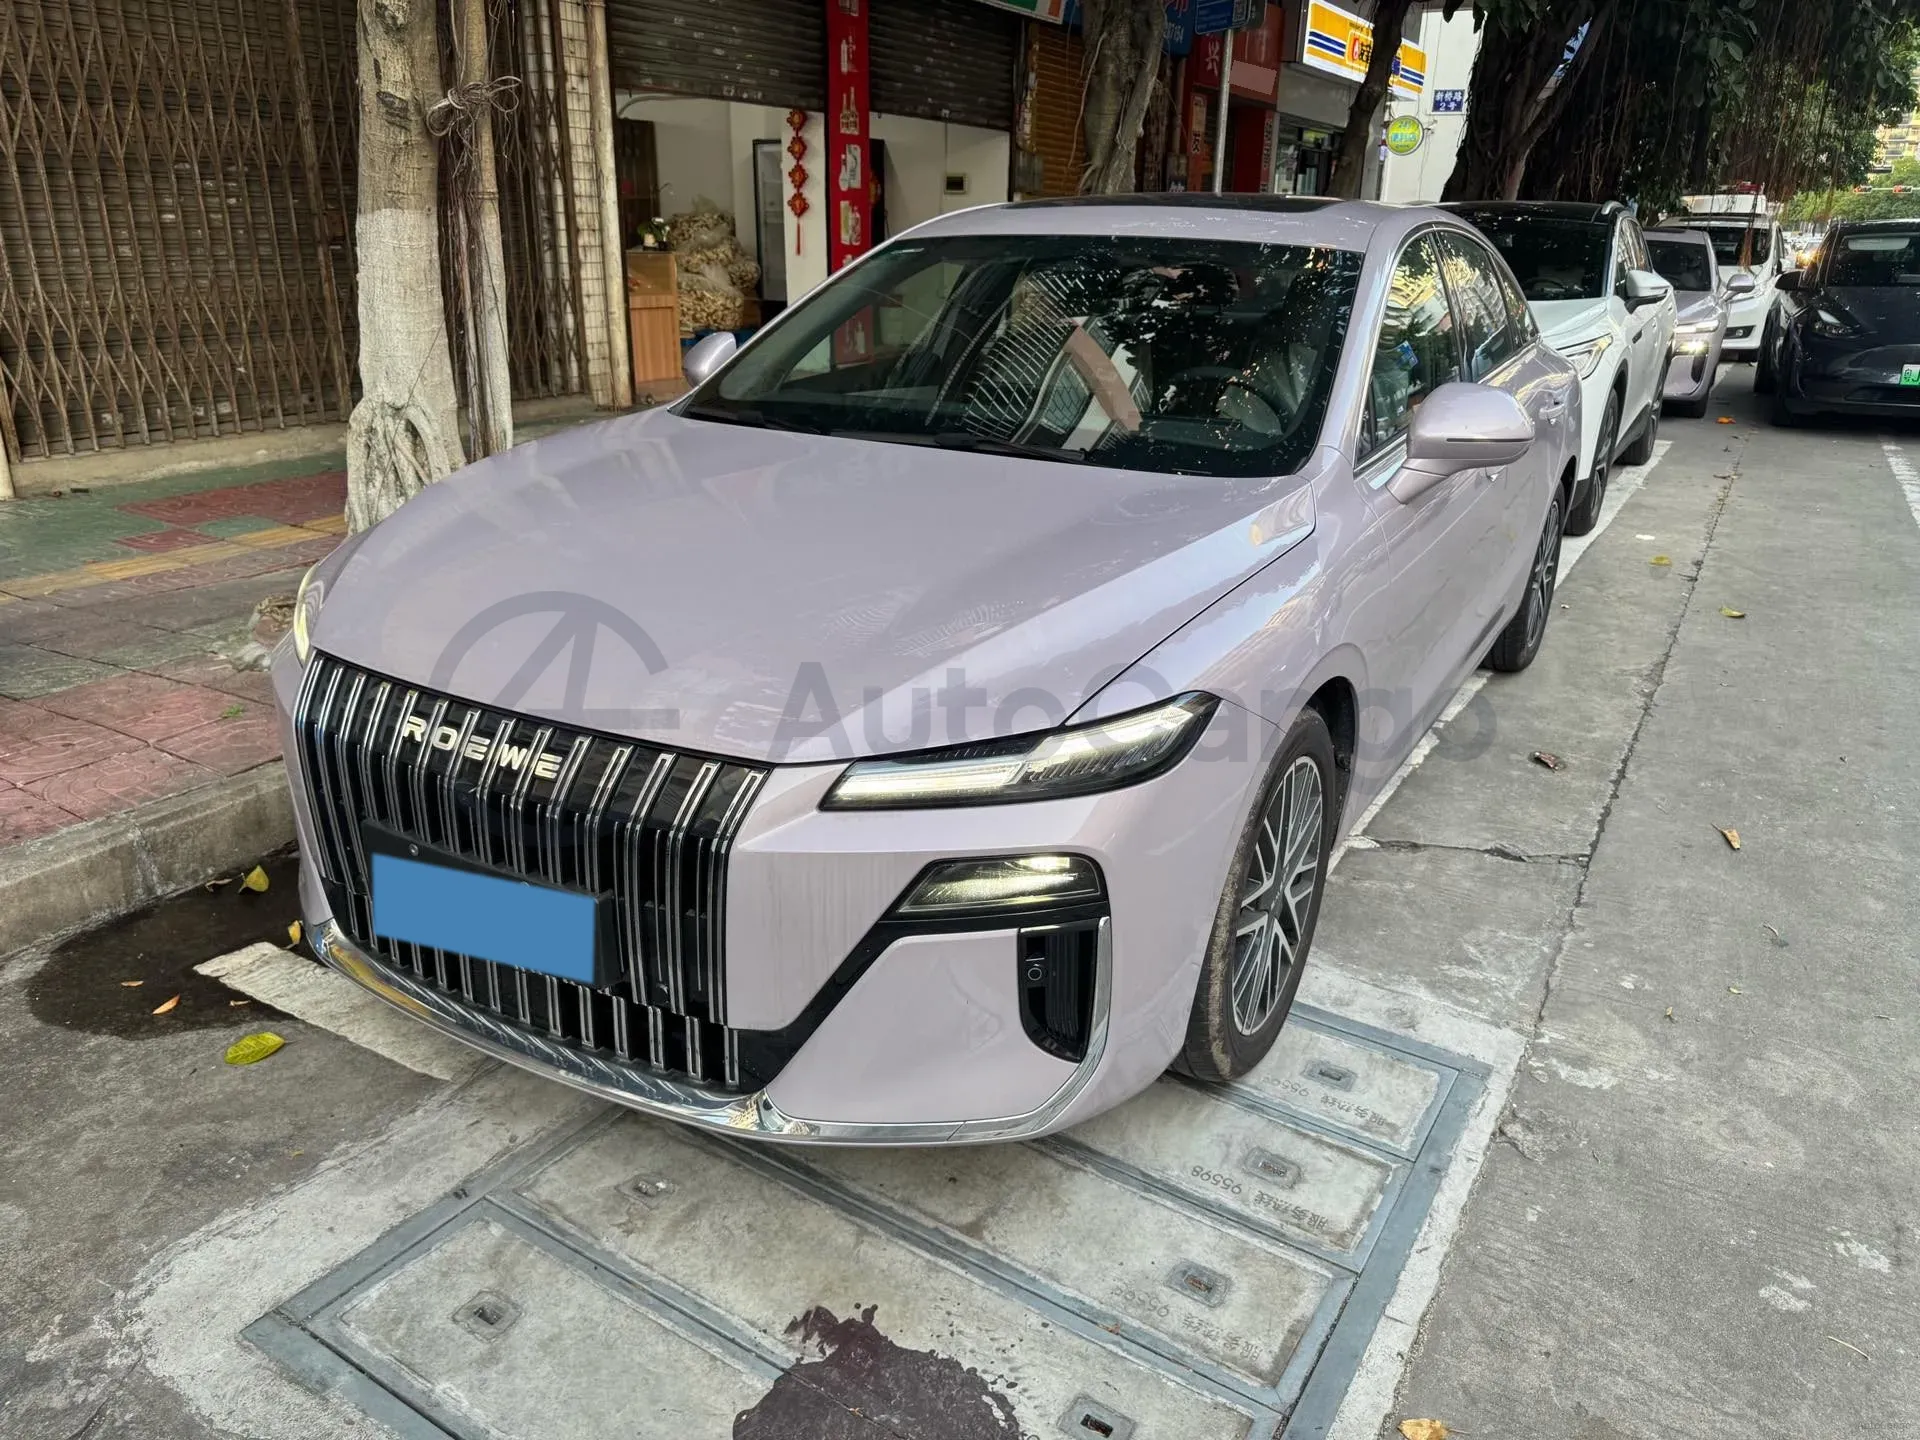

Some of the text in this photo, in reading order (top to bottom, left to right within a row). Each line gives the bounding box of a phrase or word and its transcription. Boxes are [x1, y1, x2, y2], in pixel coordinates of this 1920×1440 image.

[402, 715, 563, 779] ROEWE
[1191, 1165, 1329, 1230] 服务热线 95598
